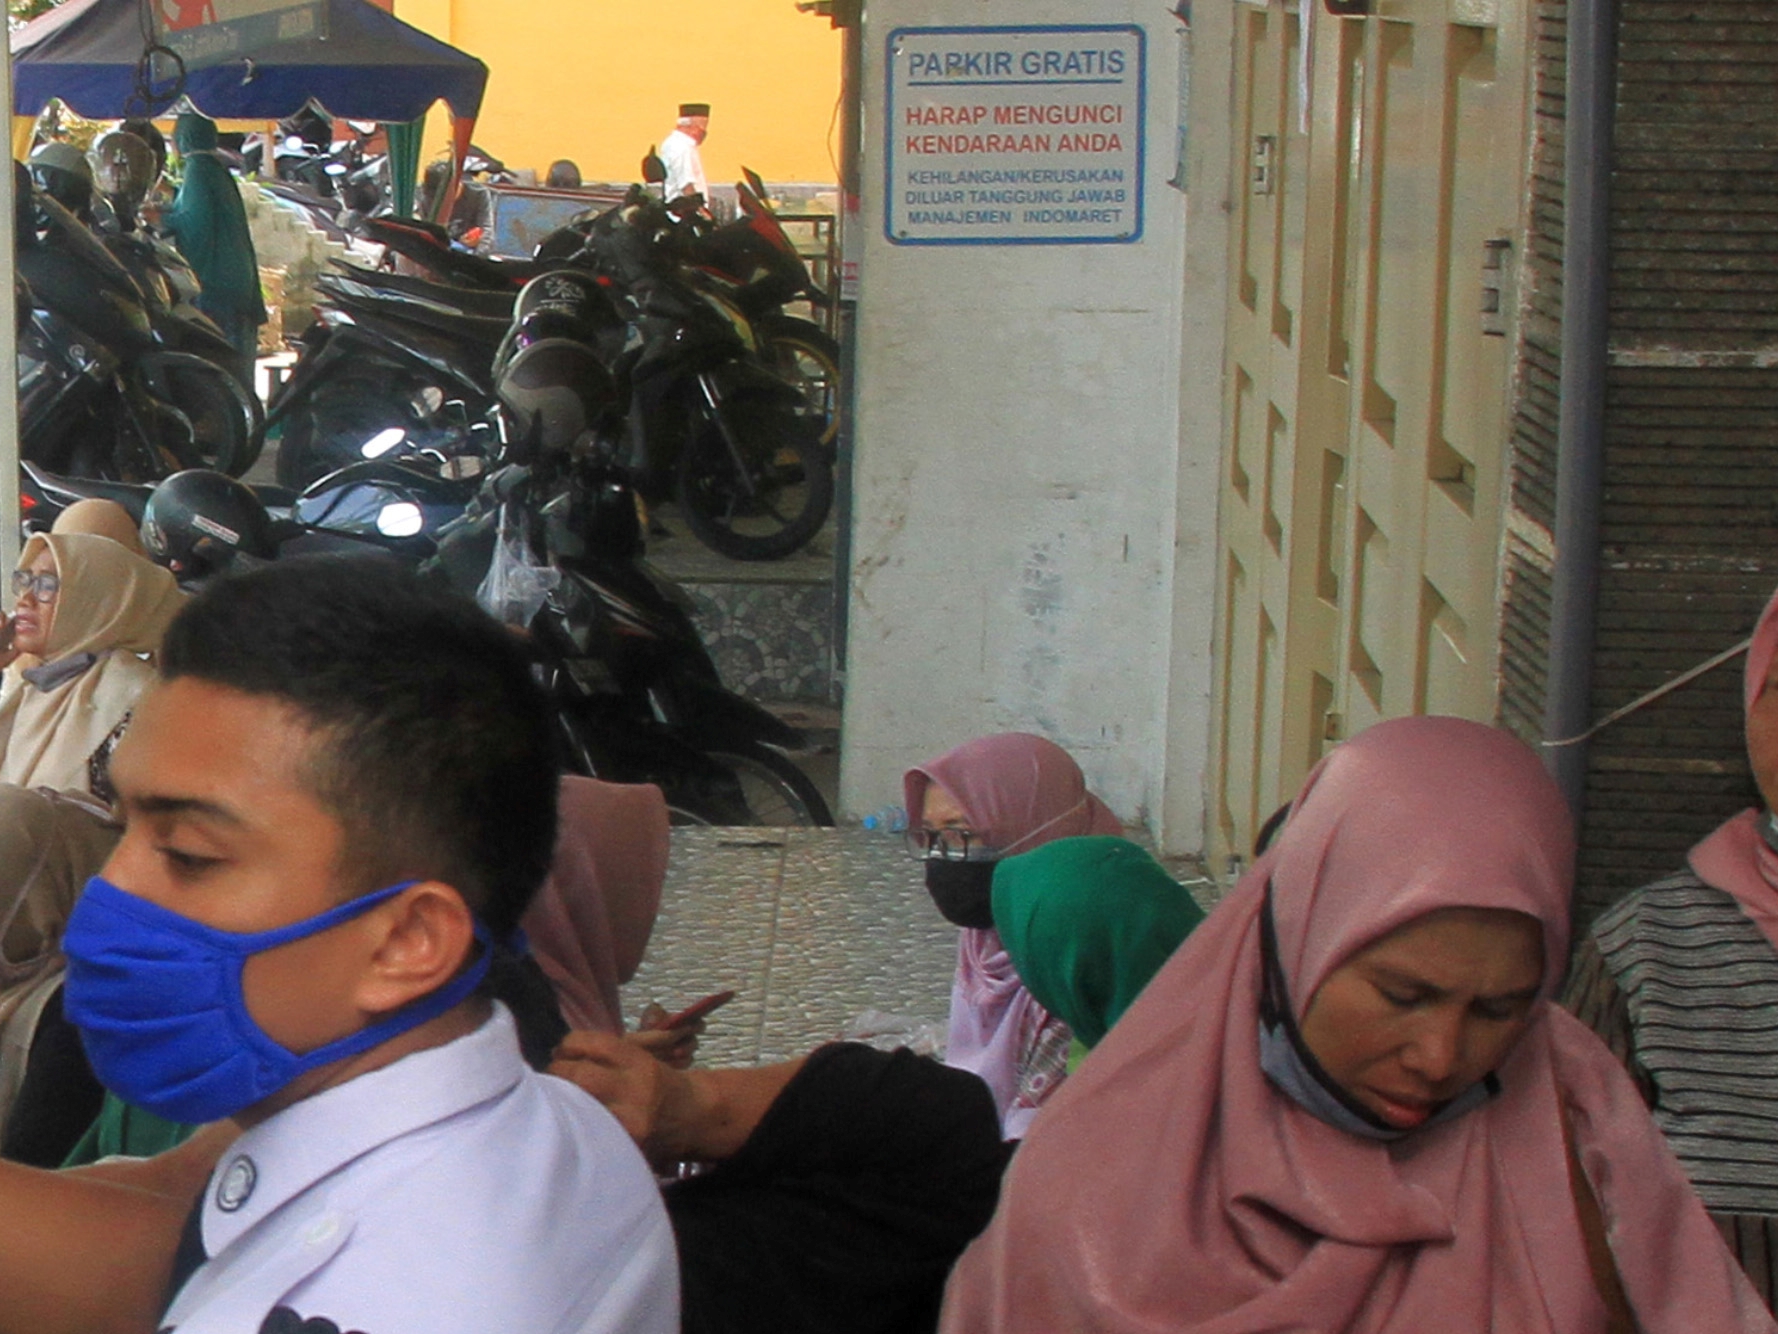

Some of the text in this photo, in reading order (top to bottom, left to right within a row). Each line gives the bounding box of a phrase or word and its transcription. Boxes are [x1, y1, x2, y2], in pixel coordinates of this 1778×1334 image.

[909, 50, 1125, 77] PARKIR GRATIS
[906, 104, 1123, 126] HARAP MENGUNCI
[906, 133, 1123, 154] KENDARAAN ANDA
[907, 168, 1123, 185] KEHILANGAN/KERUSAKAN
[906, 188, 1126, 205] DILUAR TANGGUNG JAWAB
[909, 208, 1122, 225] MANAJEMEN INDOMARET
